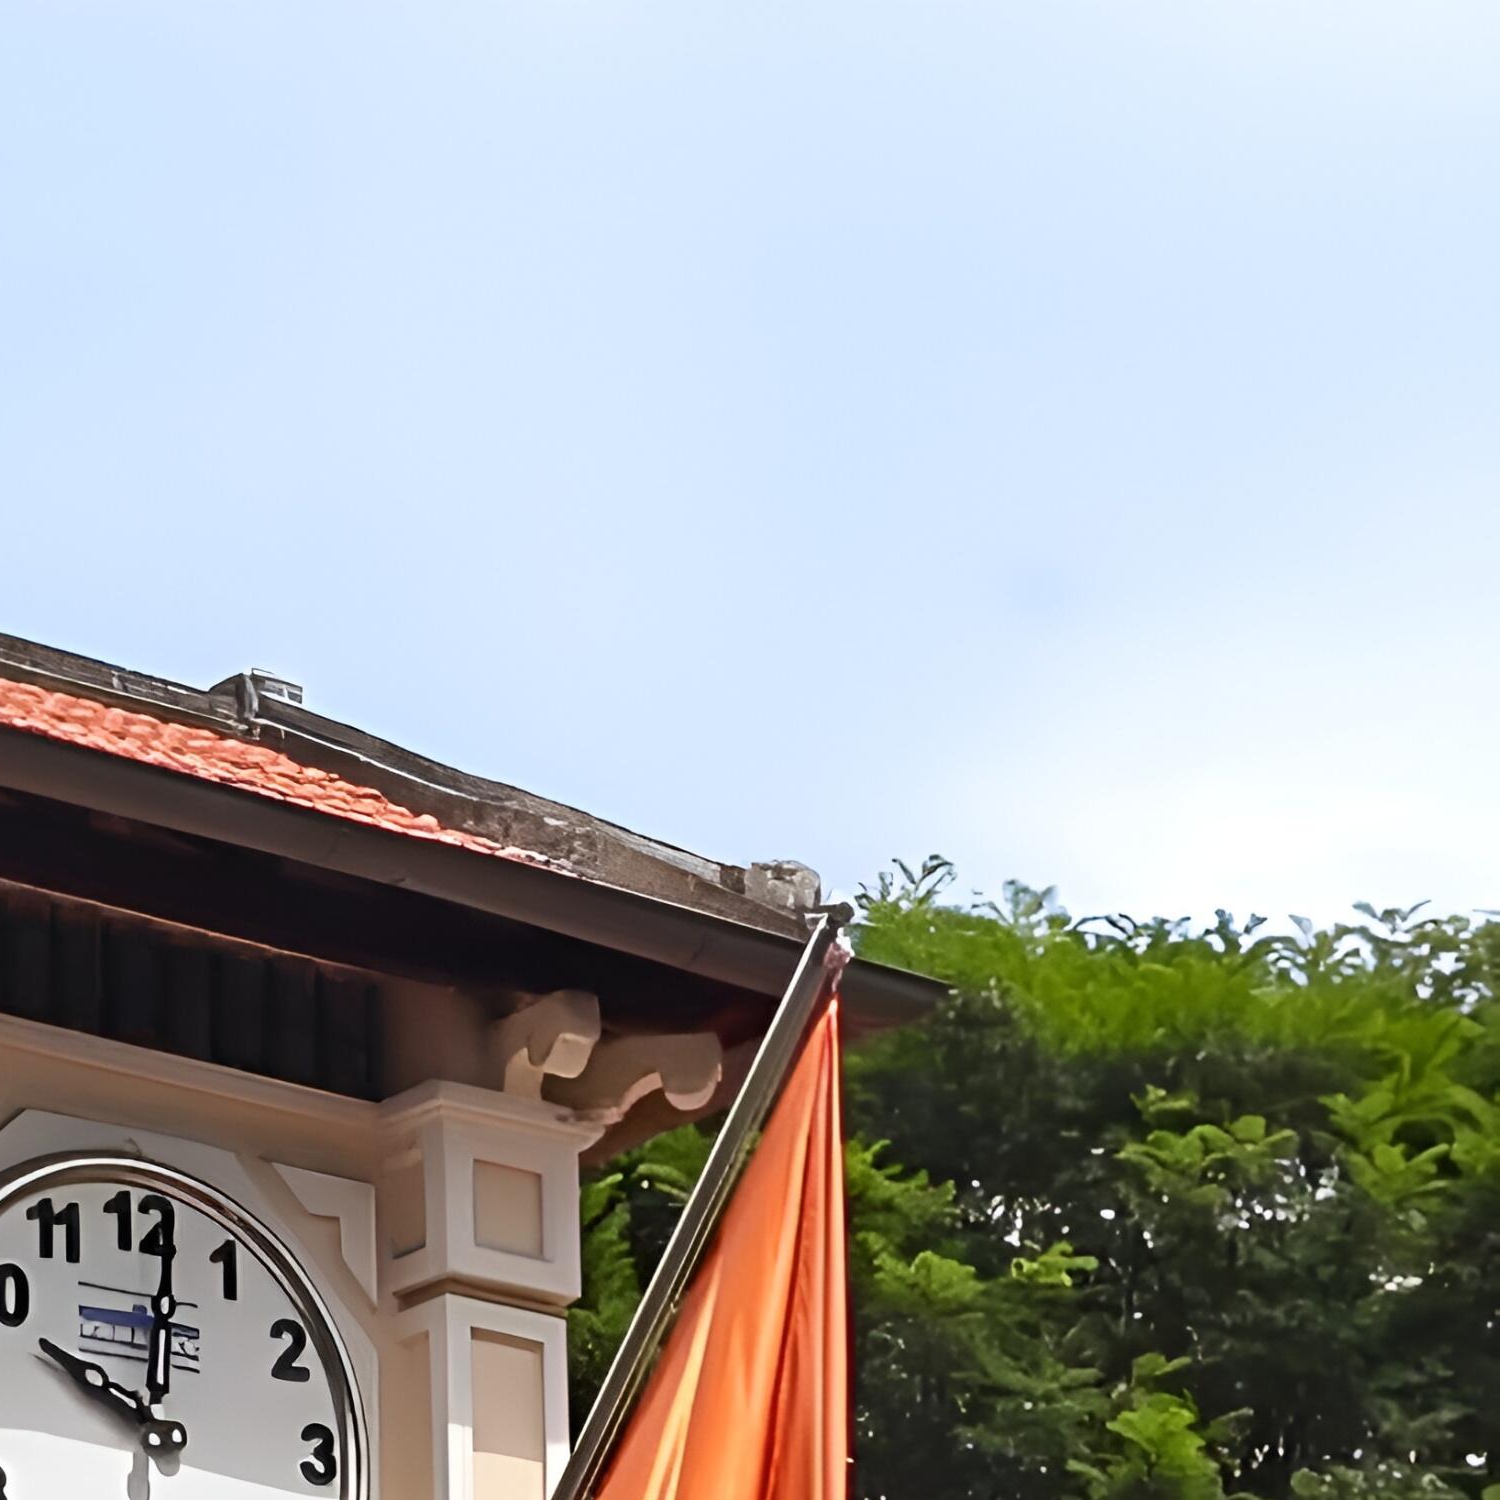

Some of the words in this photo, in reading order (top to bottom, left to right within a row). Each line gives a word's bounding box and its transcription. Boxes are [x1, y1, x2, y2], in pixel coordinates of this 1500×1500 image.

[26, 1197, 80, 1263] 11
[103, 1190, 175, 1256] 12
[209, 1239, 238, 1300] 1
[270, 1319, 310, 1383] 2
[300, 1423, 337, 1486] 3
